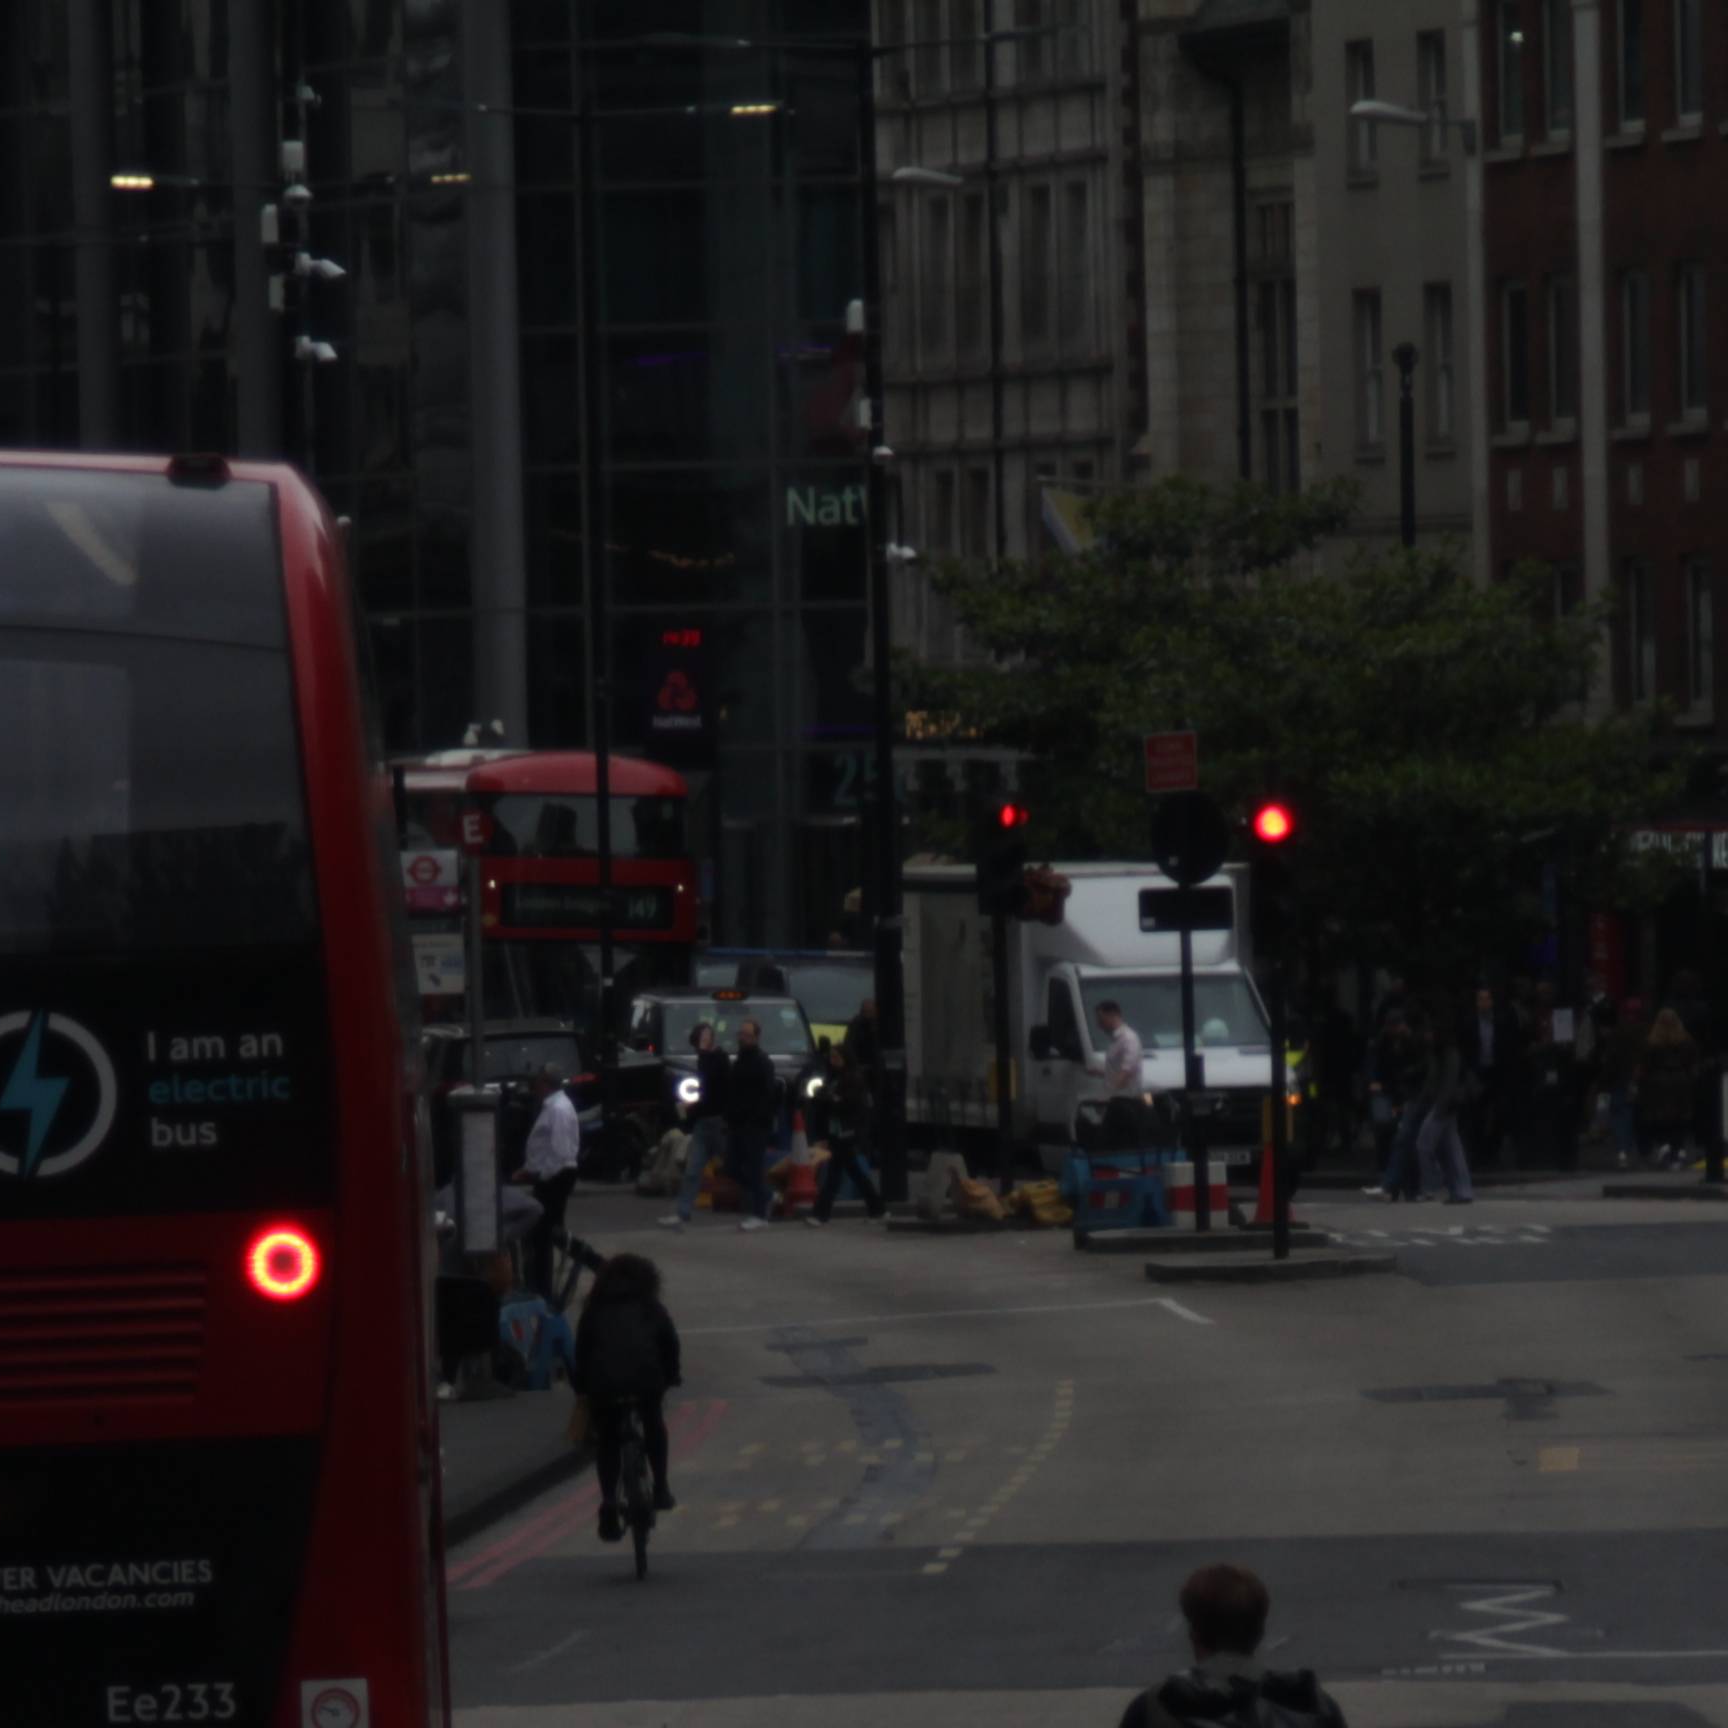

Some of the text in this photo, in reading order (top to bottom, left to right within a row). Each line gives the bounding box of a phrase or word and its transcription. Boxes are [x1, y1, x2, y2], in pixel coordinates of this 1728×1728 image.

[461, 812, 484, 845] E
[626, 893, 658, 920] 149
[146, 1029, 284, 1063] I am an
[148, 1070, 291, 1104] electric
[150, 1114, 219, 1148] bus
[47, 1559, 215, 1589] VACANCIES
[105, 1680, 238, 1725] Ee233
